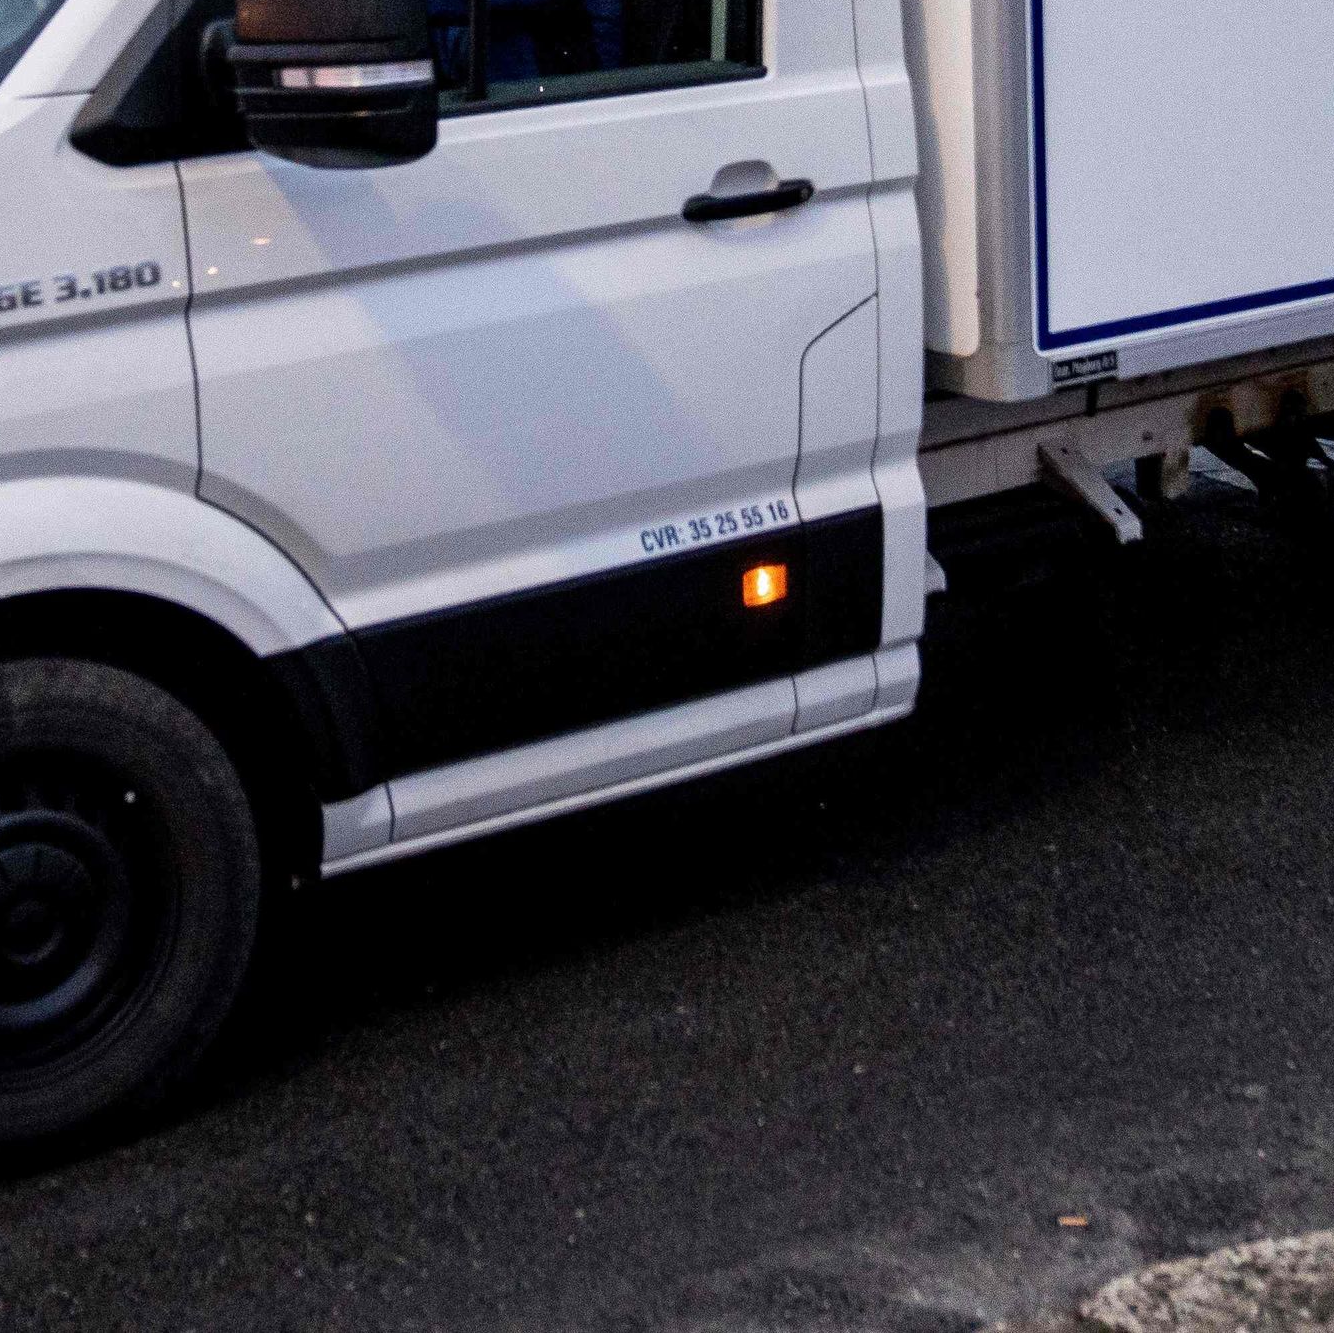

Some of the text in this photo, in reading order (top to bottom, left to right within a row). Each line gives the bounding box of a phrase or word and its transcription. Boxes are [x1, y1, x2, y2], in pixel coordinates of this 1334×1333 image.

[53, 258, 161, 304] 3.180
[640, 522, 685, 554] CVR:
[688, 516, 712, 541] 35
[714, 510, 737, 535] 25
[740, 504, 764, 529] 55
